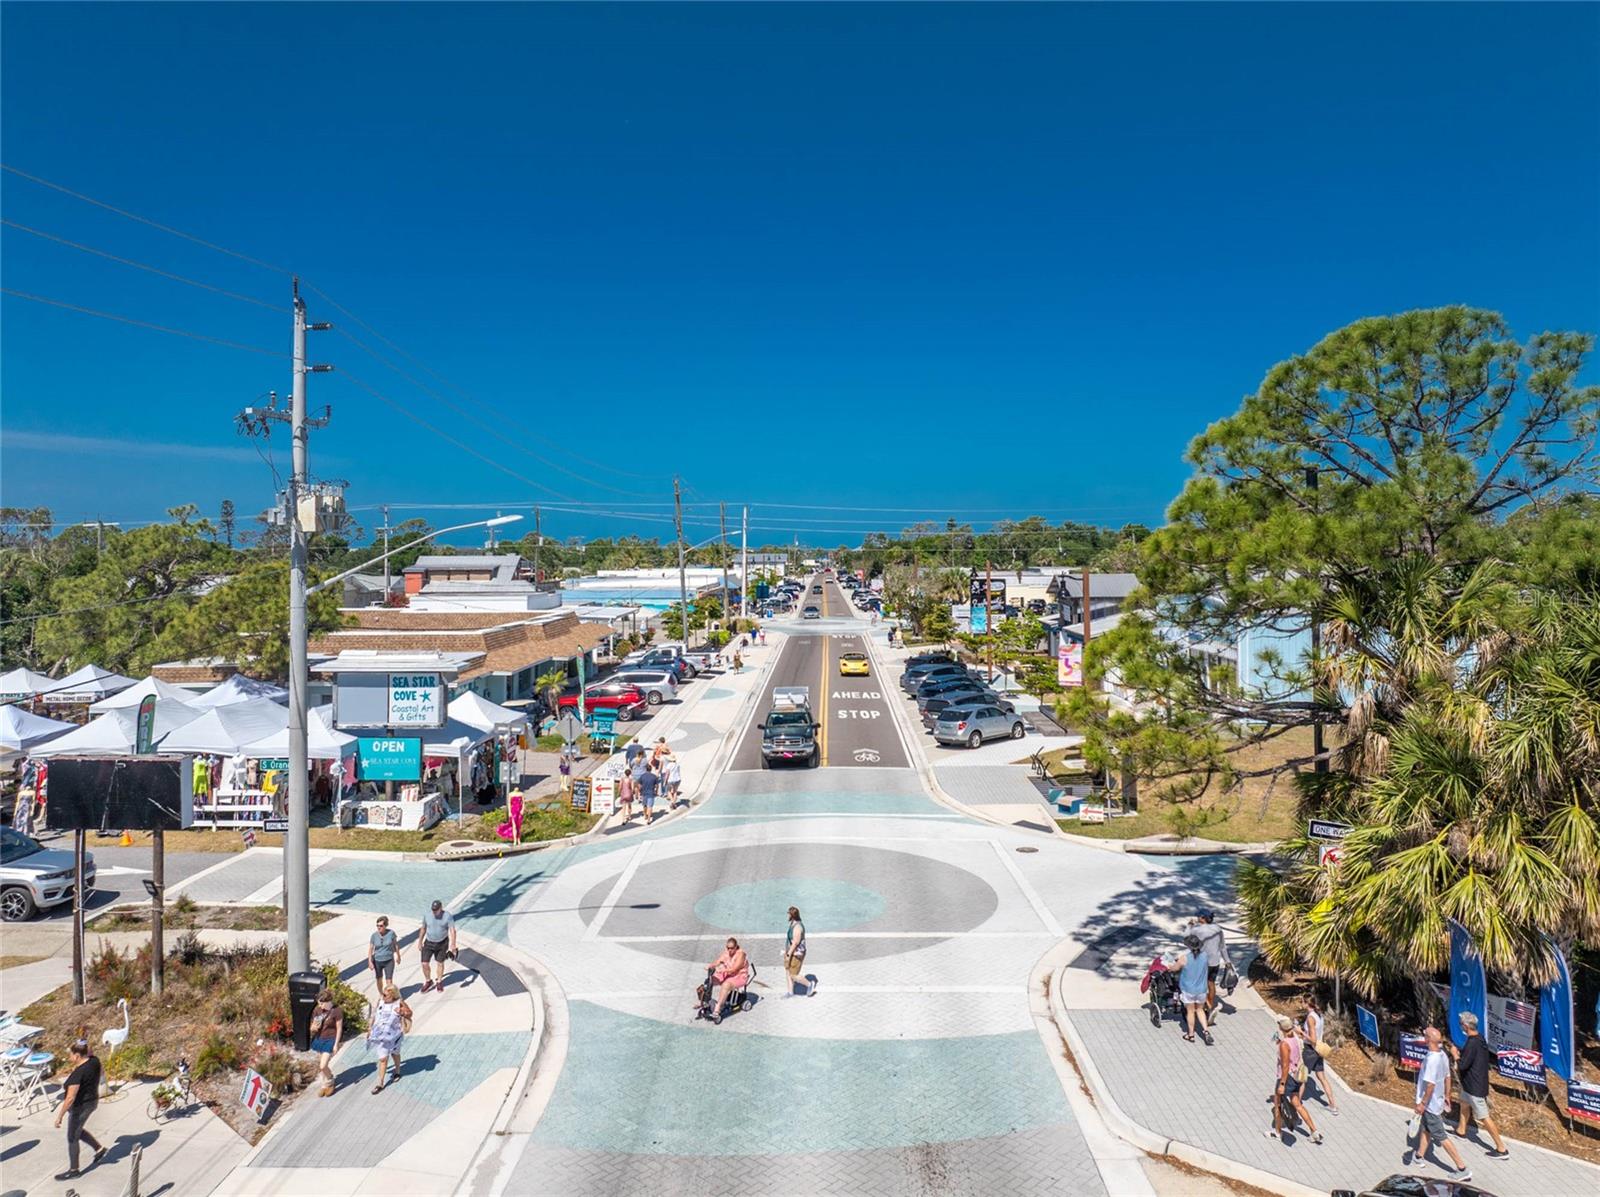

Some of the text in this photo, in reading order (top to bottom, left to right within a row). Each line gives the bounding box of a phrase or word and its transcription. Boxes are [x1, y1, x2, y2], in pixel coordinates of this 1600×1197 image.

[392, 676, 436, 688] SEA STAR
[393, 691, 417, 701] COVE
[832, 691, 881, 699] AHEAD
[391, 704, 434, 713] Coastal Art
[406, 713, 426, 721] Gifts
[838, 710, 880, 719] STOP
[372, 740, 405, 752] OPEN
[262, 761, 267, 769] S
[1315, 825, 1332, 834] ONE
[1503, 1058, 1516, 1068] by
[1500, 1065, 1514, 1075] Vote
